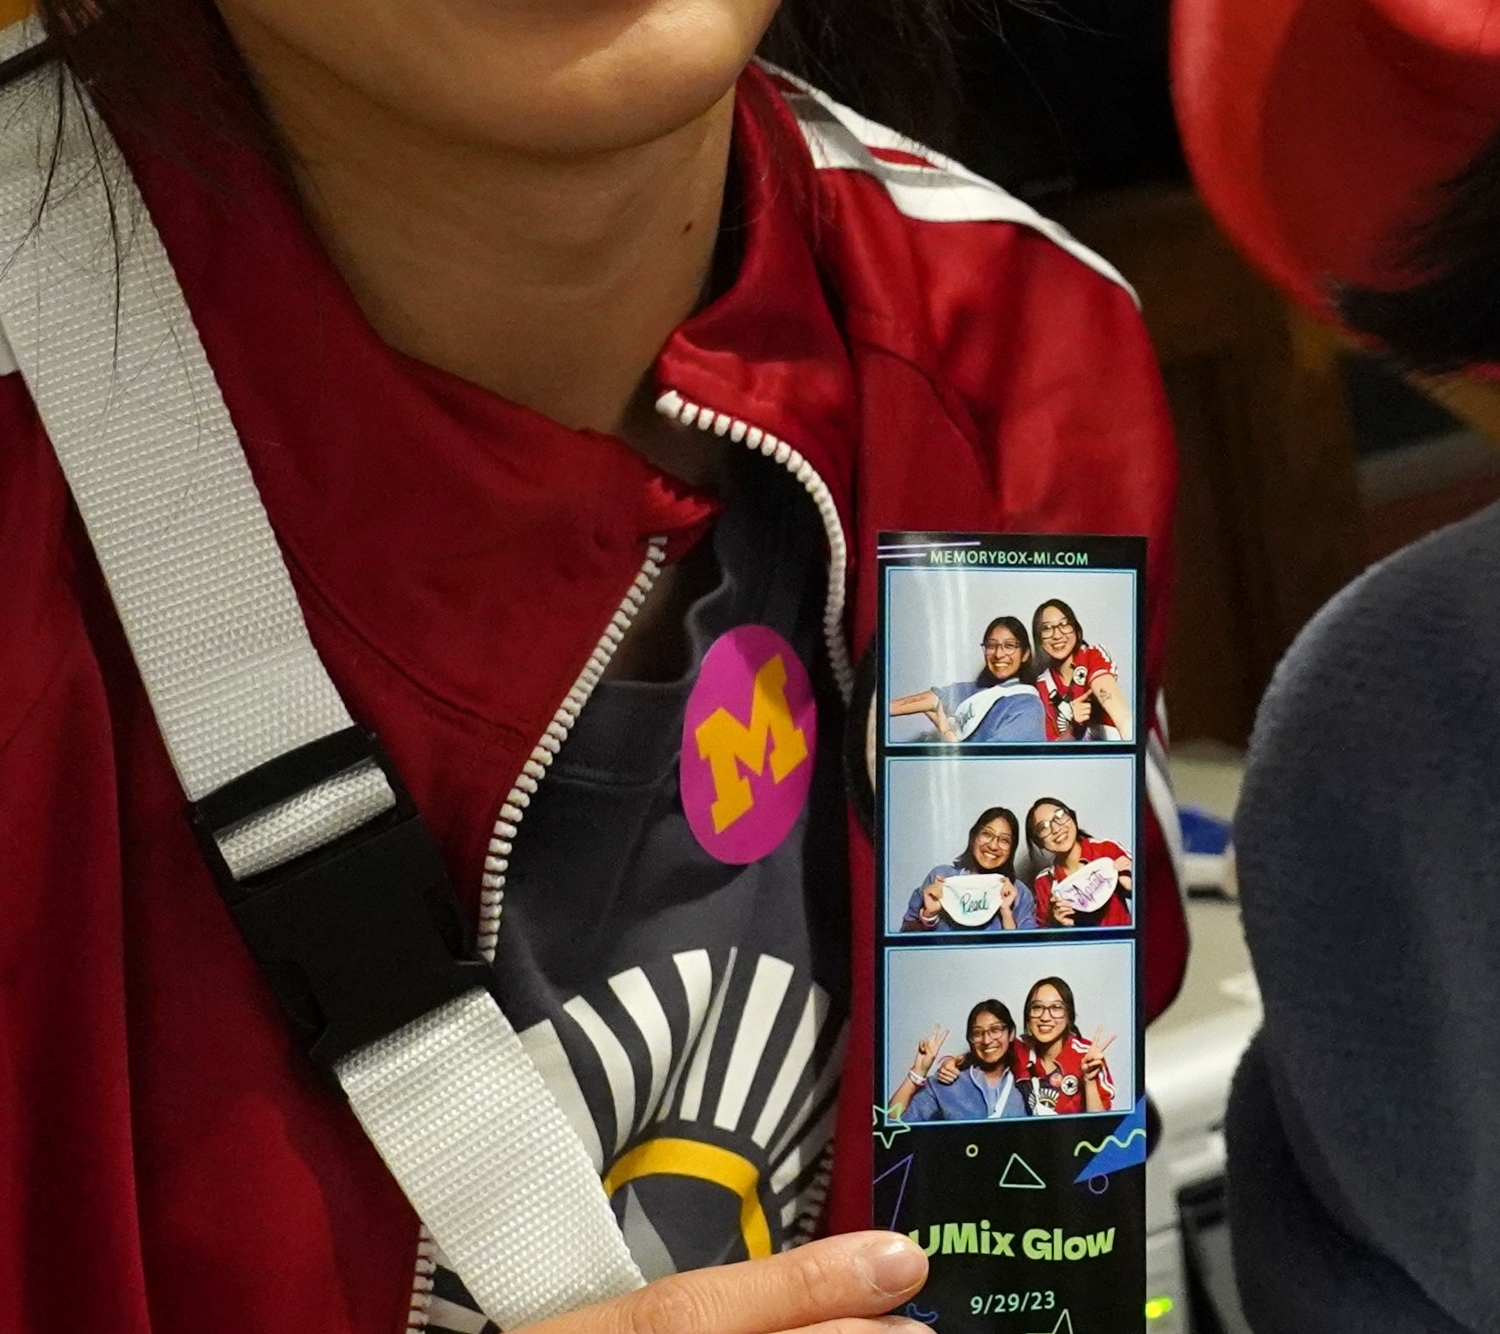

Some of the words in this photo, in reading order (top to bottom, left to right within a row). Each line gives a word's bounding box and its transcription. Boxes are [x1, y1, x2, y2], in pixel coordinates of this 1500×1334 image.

[929, 550, 1089, 566] MEMORYBOX-MI.COM
[695, 653, 808, 835] M
[908, 1219, 1016, 1258] UMix
[1022, 1227, 1116, 1261] Glow
[969, 1290, 1056, 1315] 9/29/23
